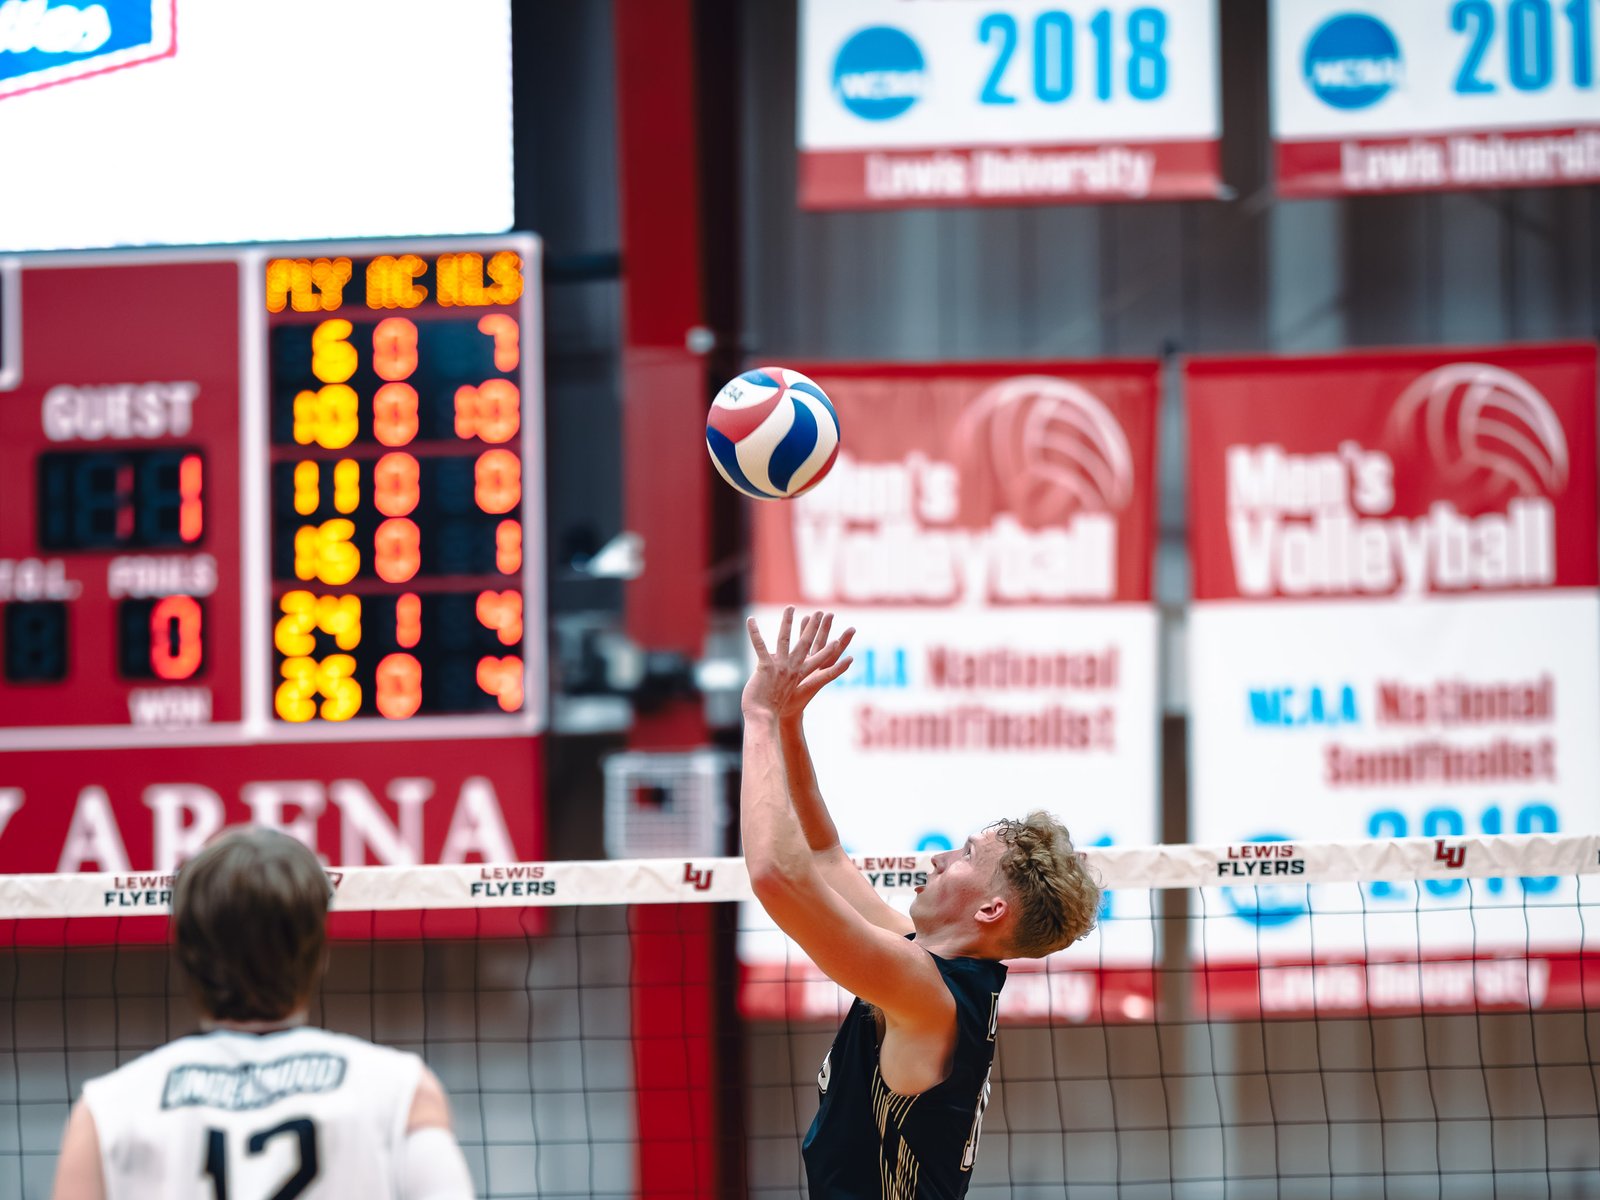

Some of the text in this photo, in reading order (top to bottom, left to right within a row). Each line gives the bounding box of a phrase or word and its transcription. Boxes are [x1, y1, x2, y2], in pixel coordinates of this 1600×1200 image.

[977, 8, 1168, 105] 2018
[864, 144, 1155, 199] Lewis University
[1341, 136, 1445, 191] Lewis
[312, 319, 358, 383] 6
[477, 314, 520, 372] 7
[42, 381, 200, 441] GUEST
[294, 458, 360, 516] 11
[1226, 440, 1395, 514] Men's
[496, 519, 522, 575] 1
[798, 511, 1117, 606] Volleyball
[1229, 497, 1557, 604] Volleyball
[151, 594, 202, 680] 0
[396, 592, 421, 648] 1
[476, 590, 523, 646] 4
[476, 655, 524, 712] 4
[925, 643, 1119, 691] National
[1247, 671, 1556, 727] NCAA National
[854, 702, 1114, 752] Semifinalist
[1324, 737, 1557, 788] Semifinalist
[55, 776, 520, 873] ARENA
[481, 867, 545, 881] LEWIS
[682, 861, 714, 893] LU
[867, 872, 928, 888] YERS
[1217, 860, 1305, 878] FLYERS
[1227, 845, 1294, 860] LEWIS
[1434, 838, 1468, 869] LU
[103, 890, 173, 907] FLYER
[470, 881, 557, 898] FLYERS
